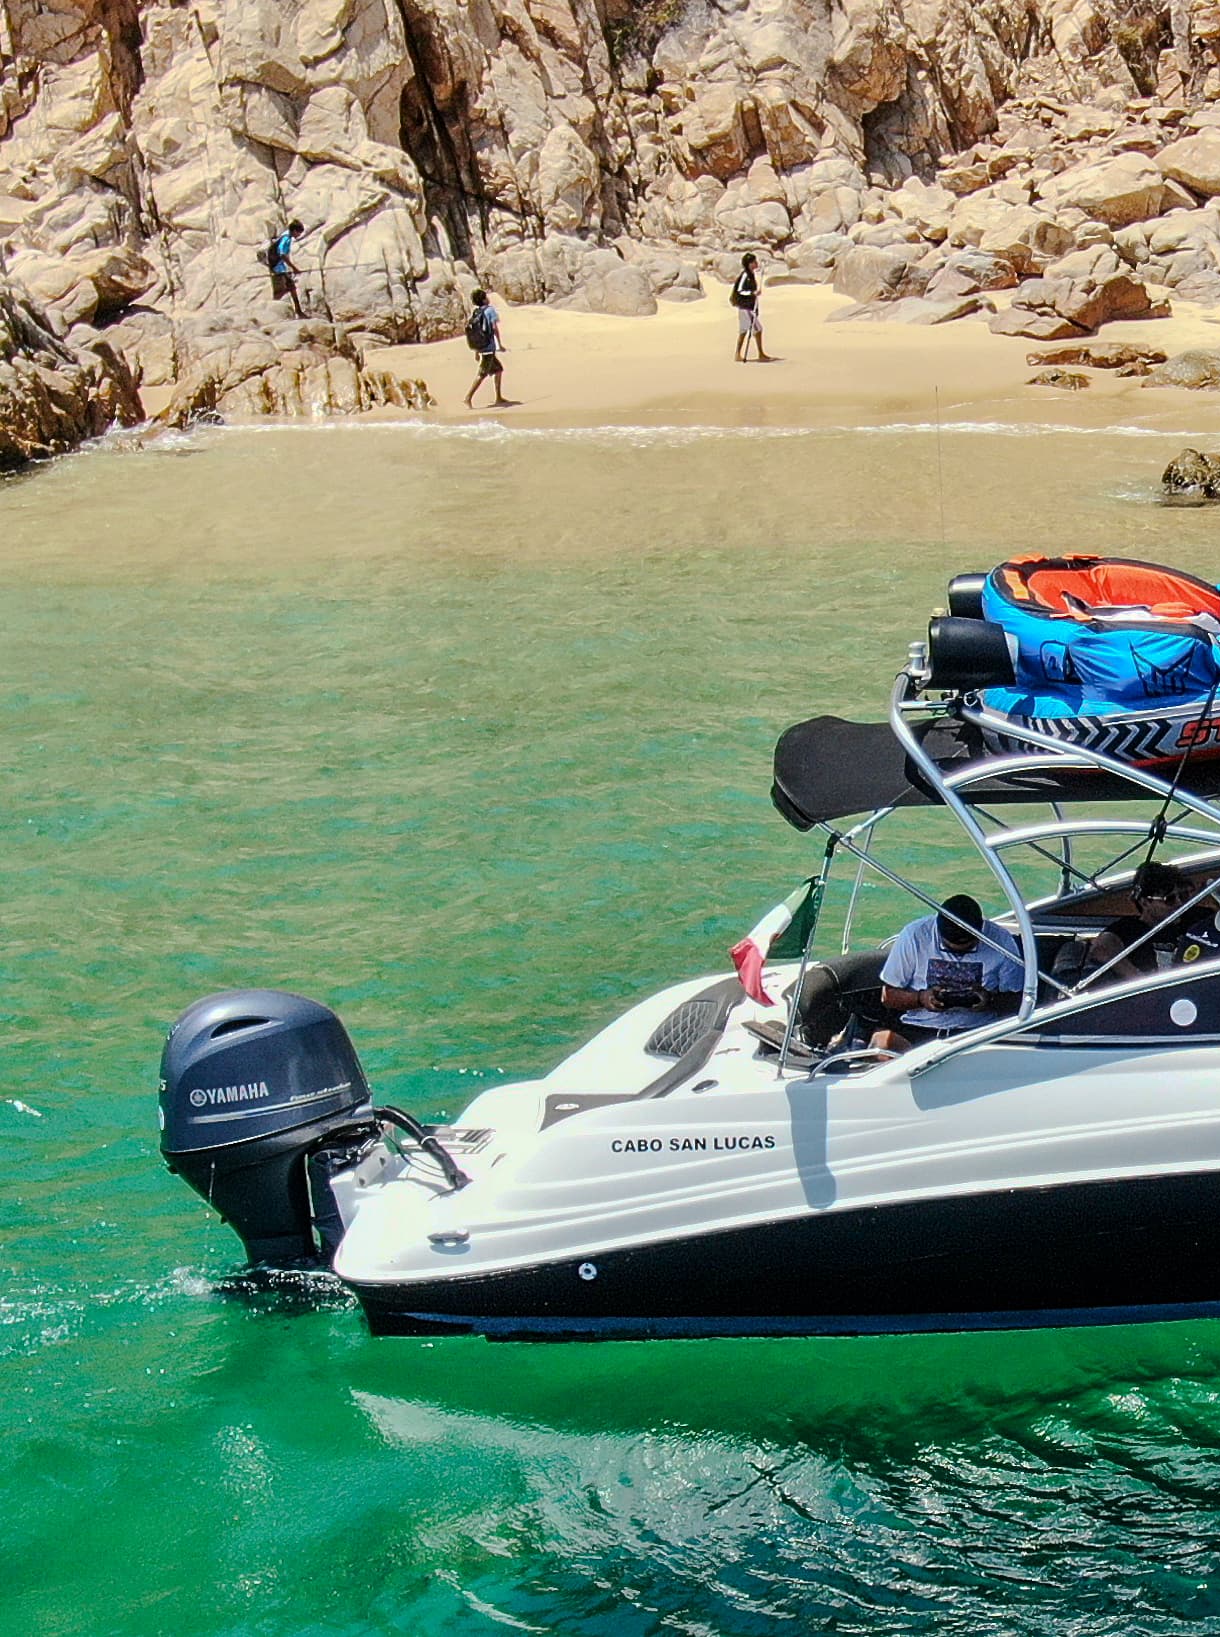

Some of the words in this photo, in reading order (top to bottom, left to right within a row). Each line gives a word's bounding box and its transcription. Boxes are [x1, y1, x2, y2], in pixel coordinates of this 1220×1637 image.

[206, 1081, 269, 1104] YAMAHA
[611, 1139, 663, 1153] CABO
[669, 1137, 707, 1151] SAN
[713, 1135, 776, 1150] LUCAS
